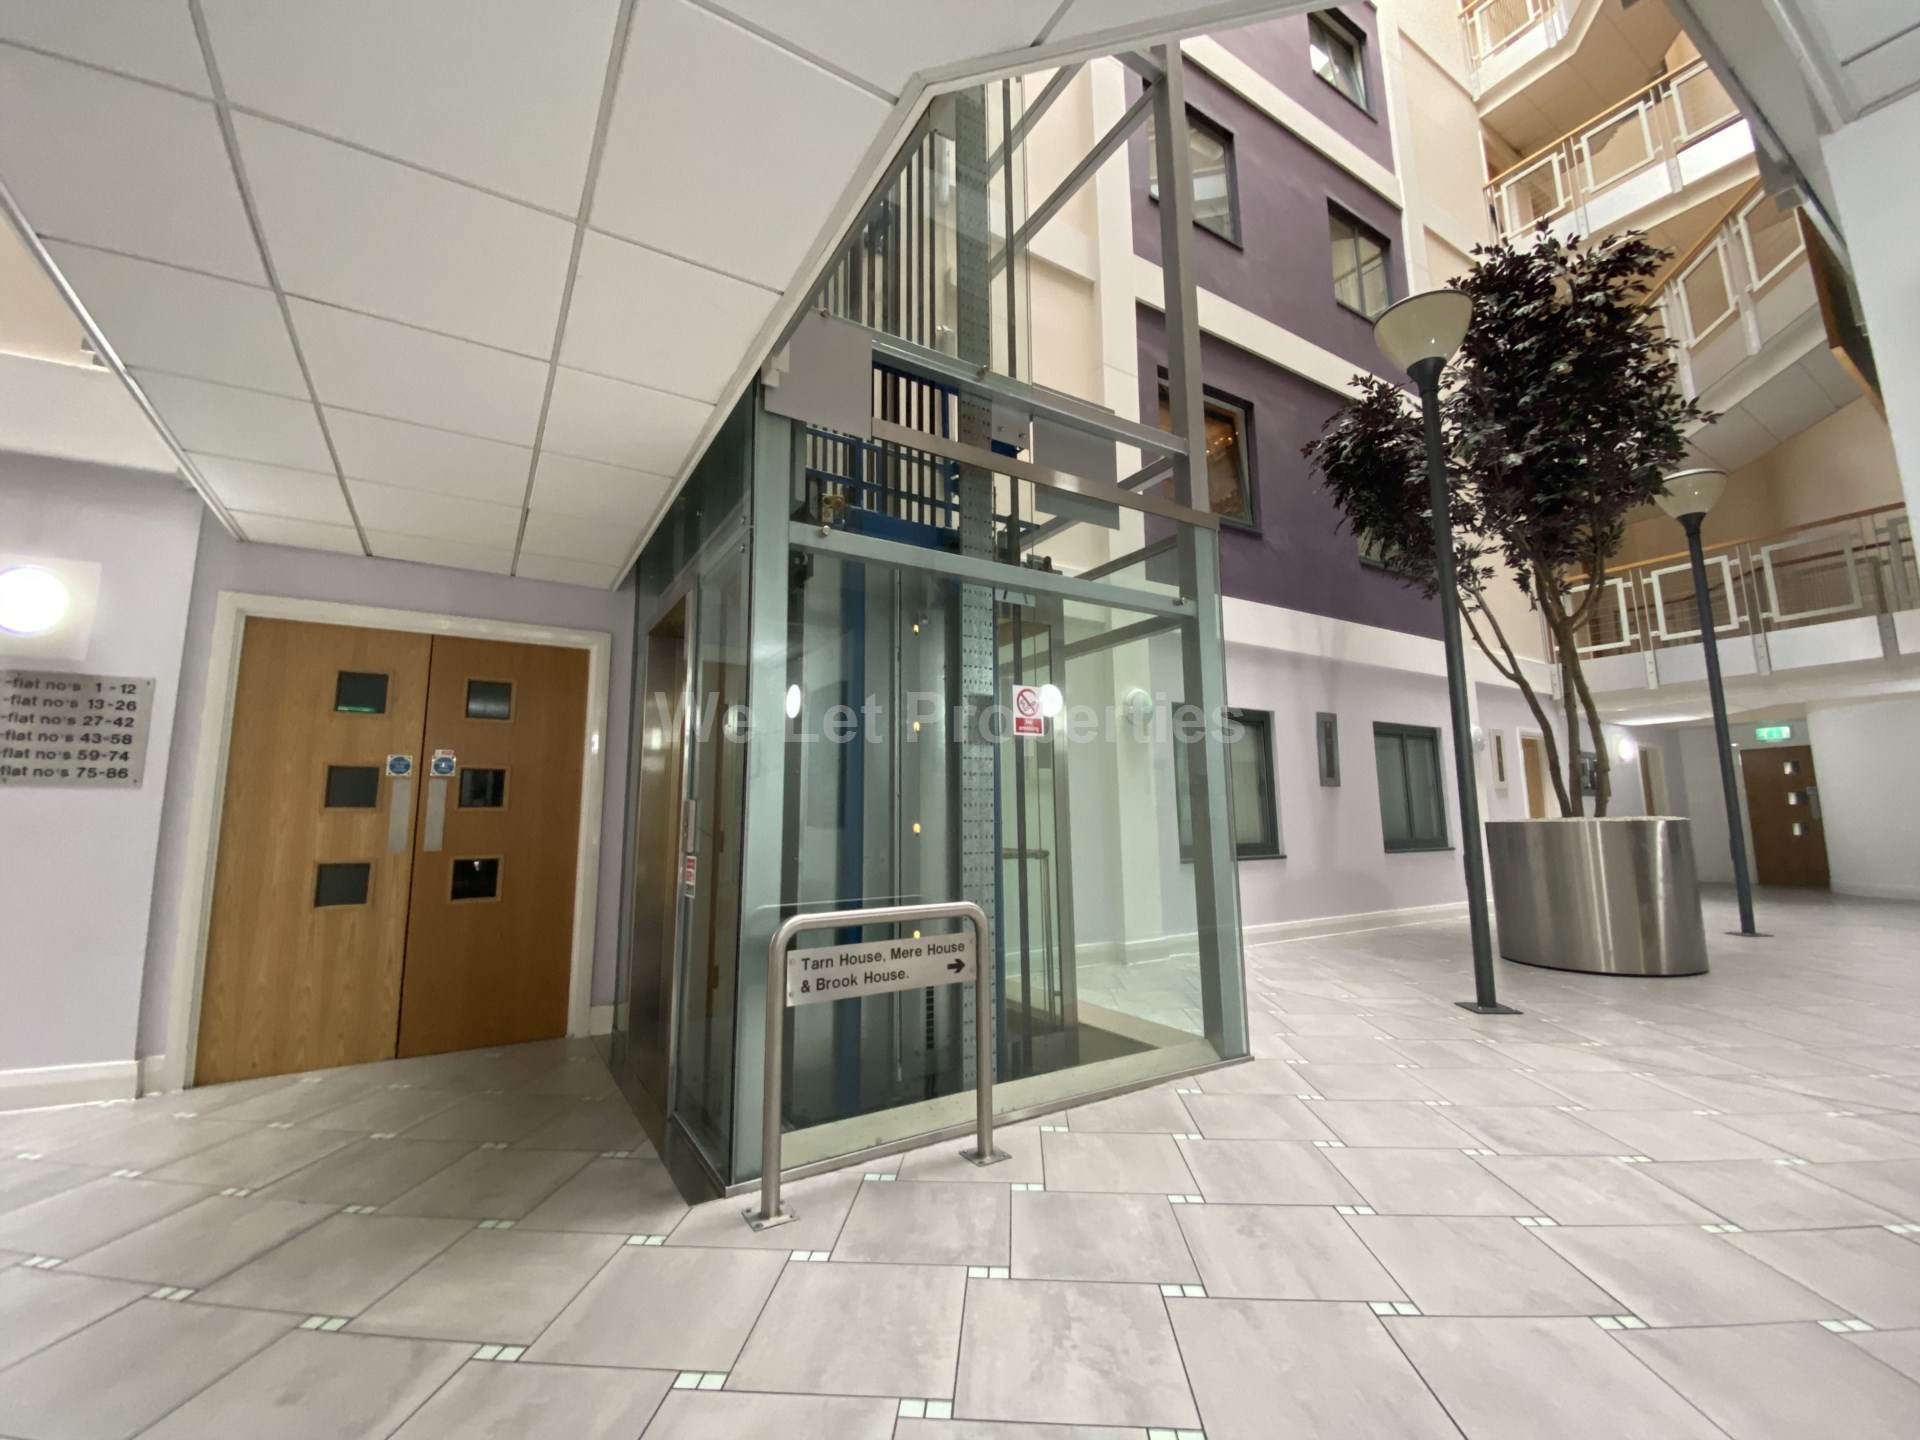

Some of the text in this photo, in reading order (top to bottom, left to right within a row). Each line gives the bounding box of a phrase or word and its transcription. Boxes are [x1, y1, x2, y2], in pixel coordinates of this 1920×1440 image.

[82, 716, 135, 727] 27-42
[80, 733, 132, 745] 43-58
[78, 750, 129, 761] 59-74
[77, 767, 129, 778] 75-86
[801, 941, 965, 971] Tarn House, Mere House
[800, 969, 910, 994] & Brook House.
